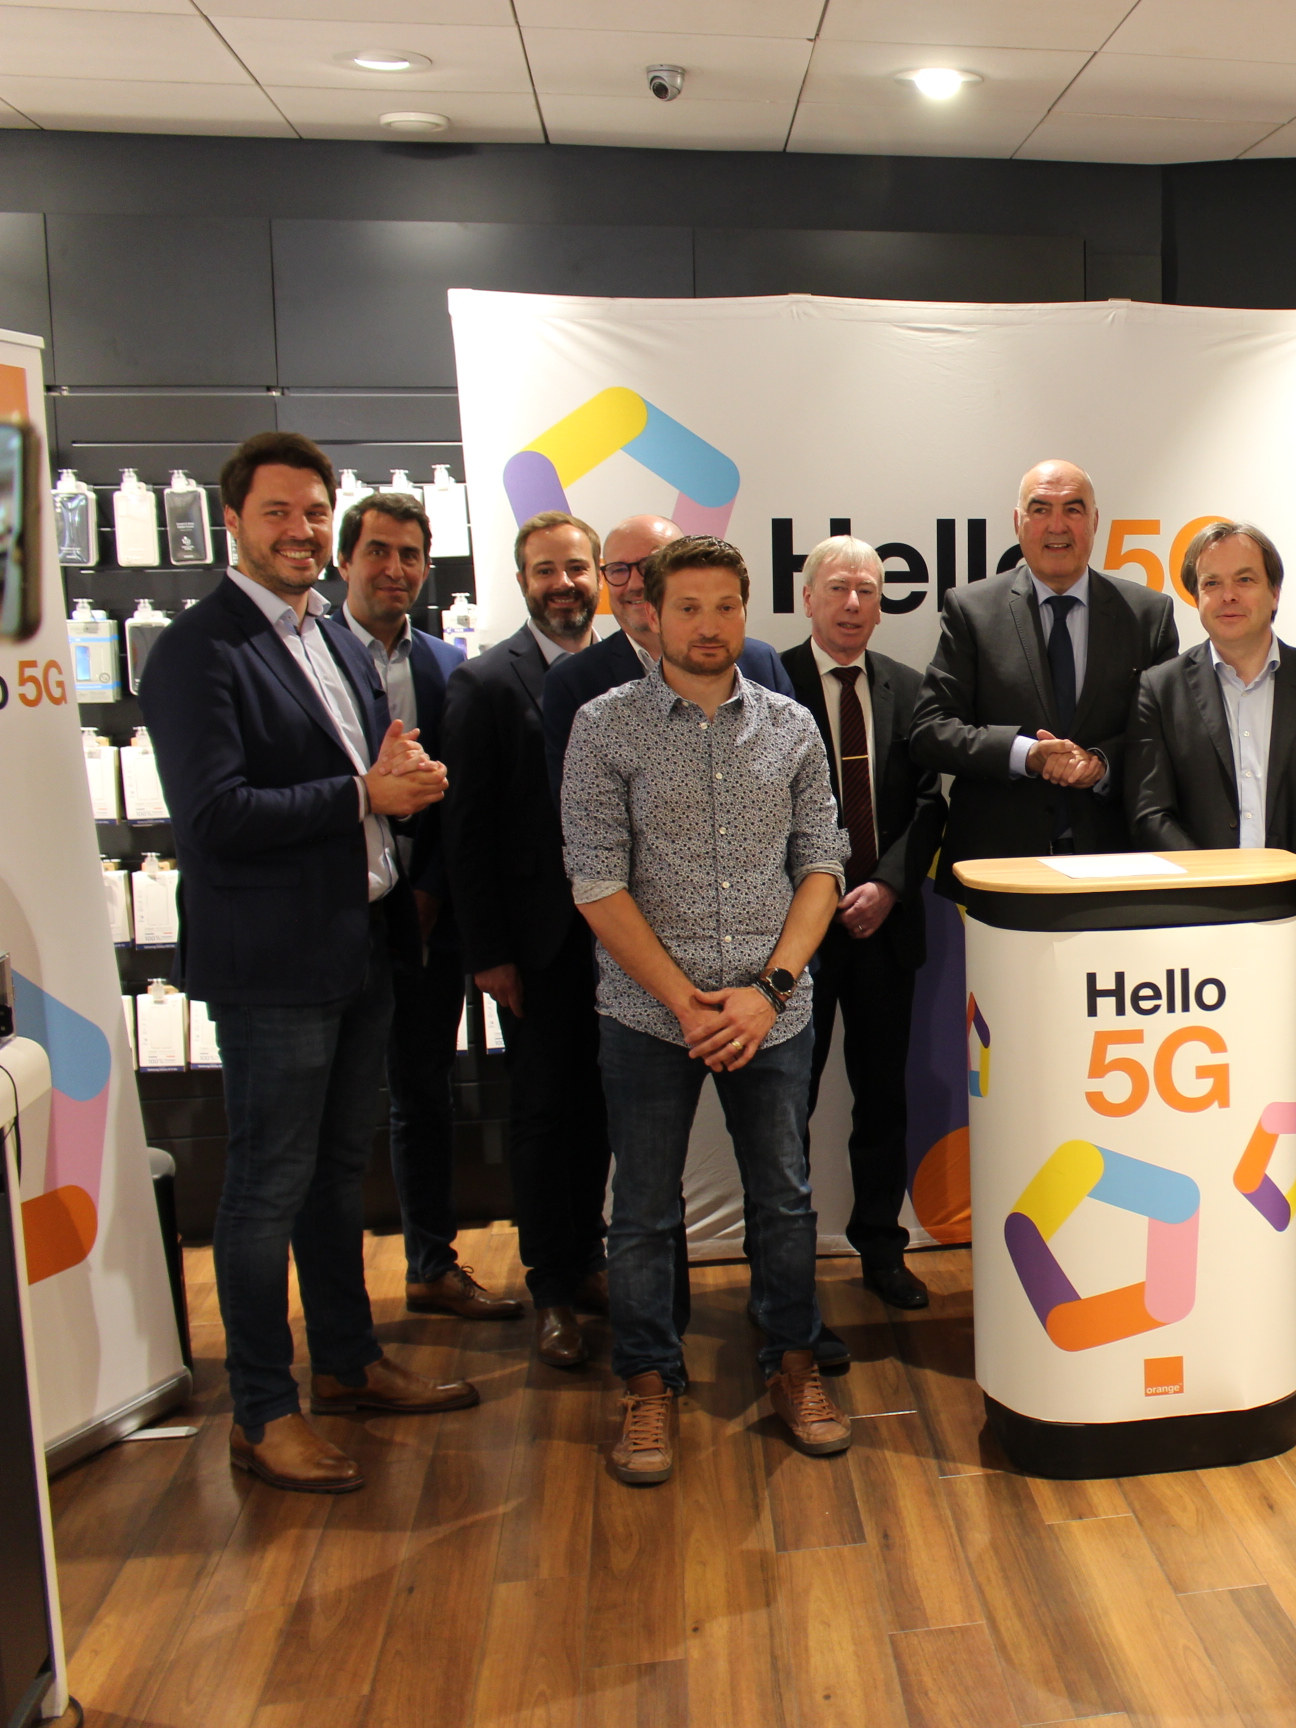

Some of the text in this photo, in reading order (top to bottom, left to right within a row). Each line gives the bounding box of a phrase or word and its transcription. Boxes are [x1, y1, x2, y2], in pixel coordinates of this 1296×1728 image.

[771, 517, 1028, 615] Hell
[18, 659, 68, 708] 5G
[1086, 968, 1227, 1018] Hello
[1084, 1025, 1231, 1118] 5G
[1146, 1384, 1181, 1395] orange
